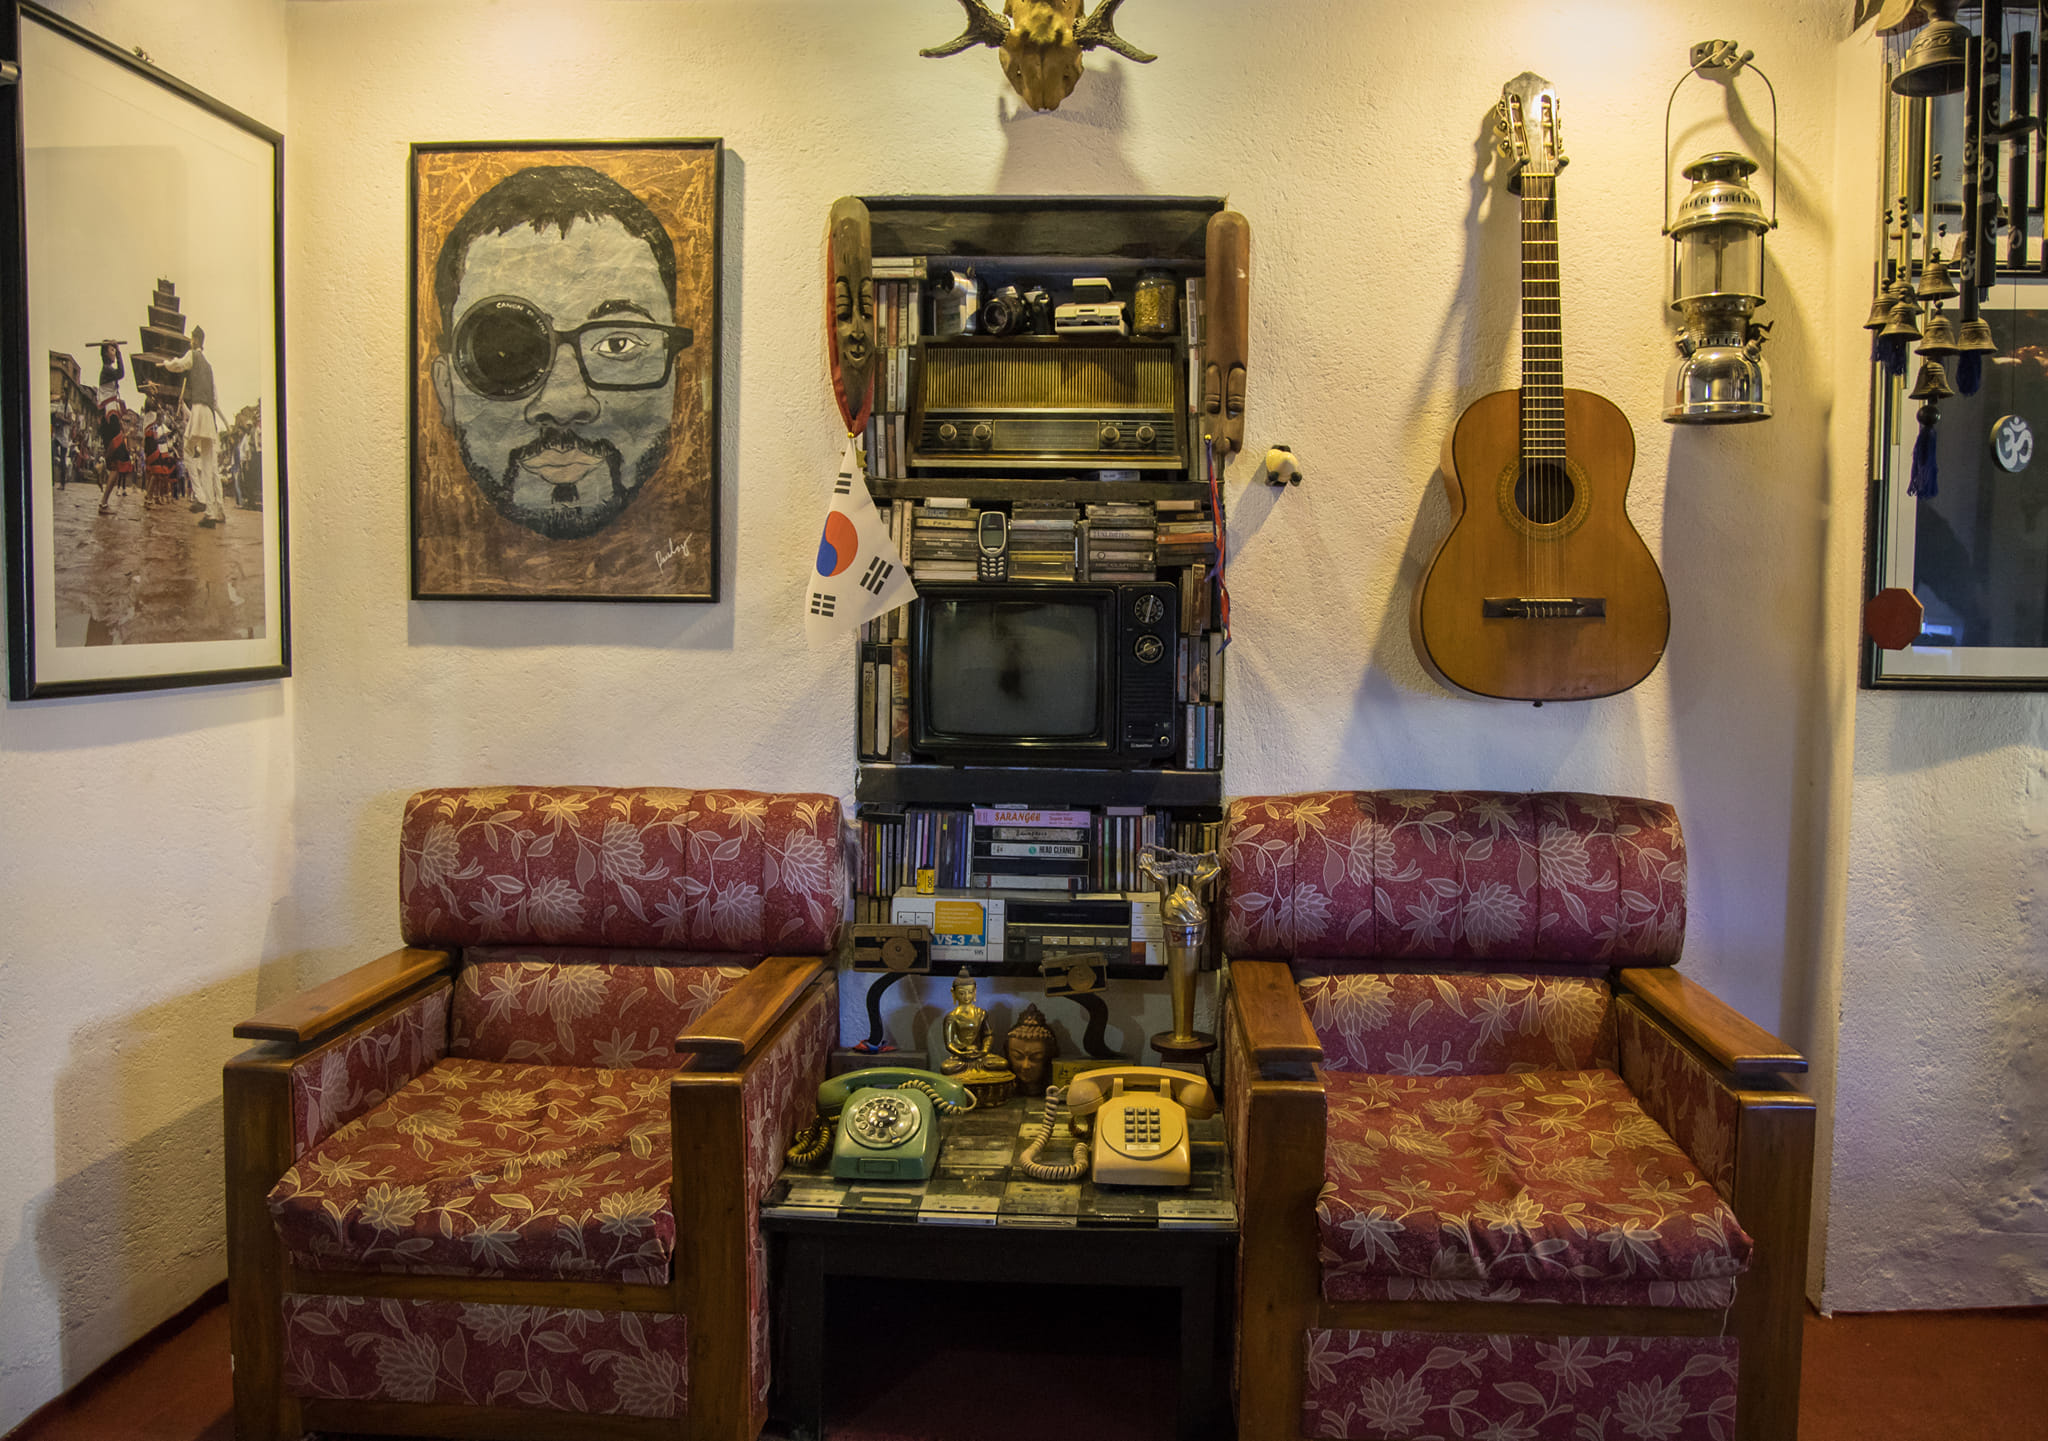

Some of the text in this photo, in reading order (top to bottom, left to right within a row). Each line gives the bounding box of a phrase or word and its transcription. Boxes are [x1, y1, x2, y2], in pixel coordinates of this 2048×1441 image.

[1038, 845, 1076, 855] HEAD CLEANER
[935, 935, 965, 945] VS-3
